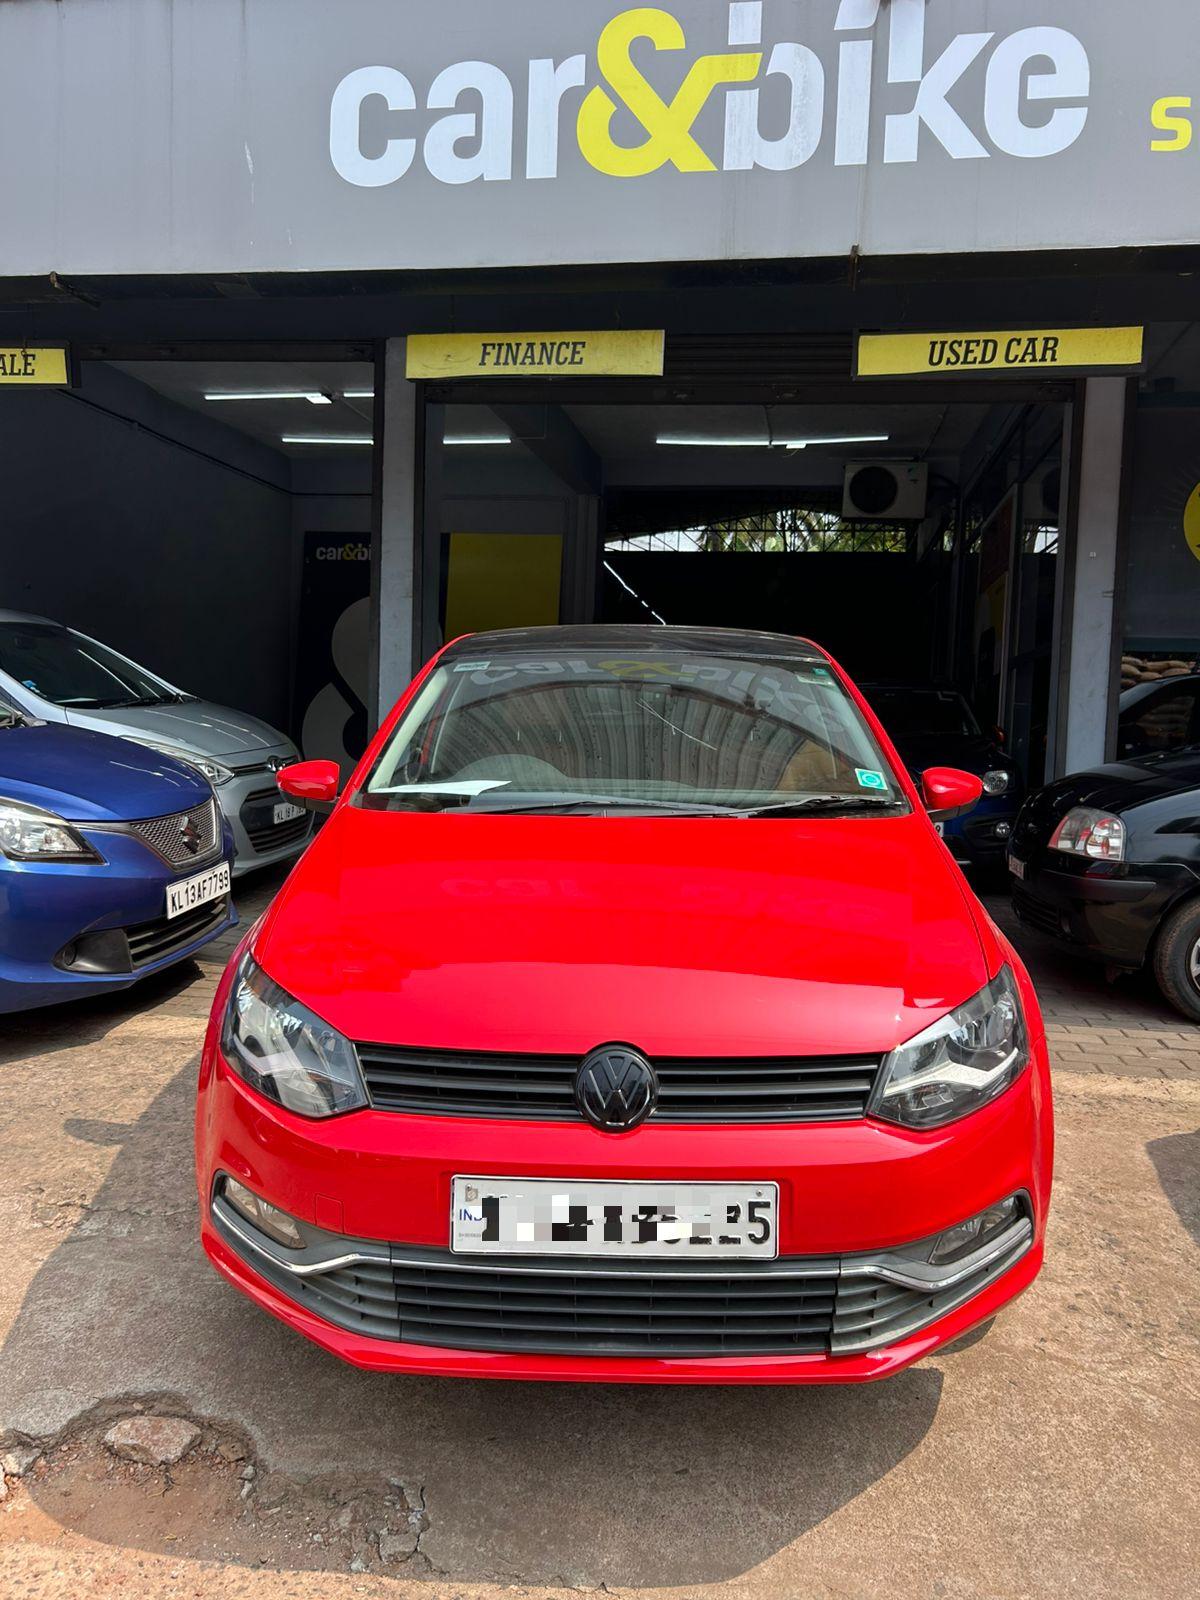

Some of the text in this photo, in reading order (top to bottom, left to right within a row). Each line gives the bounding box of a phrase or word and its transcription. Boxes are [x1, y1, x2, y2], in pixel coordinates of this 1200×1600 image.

[329, 0, 1091, 188] car&bike
[478, 341, 586, 366] FINANCE
[928, 336, 1059, 366] USED CAR
